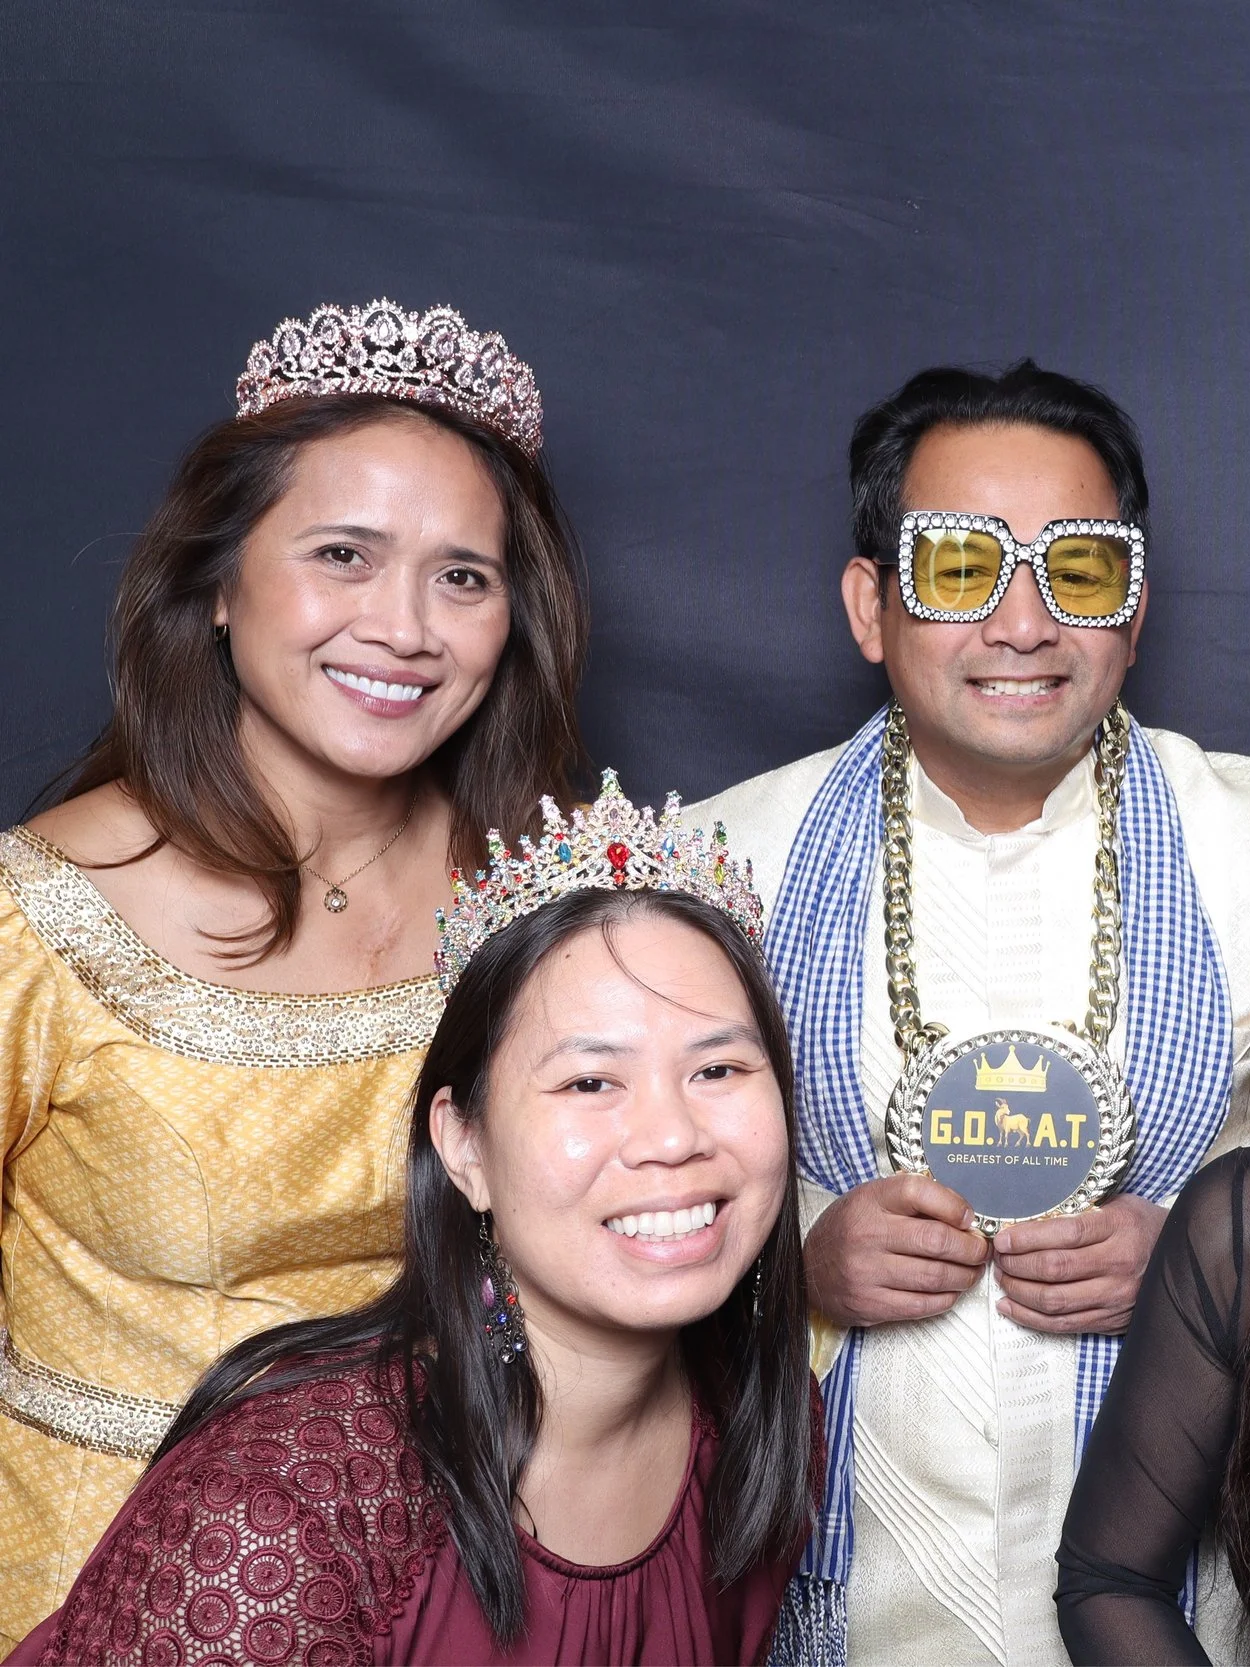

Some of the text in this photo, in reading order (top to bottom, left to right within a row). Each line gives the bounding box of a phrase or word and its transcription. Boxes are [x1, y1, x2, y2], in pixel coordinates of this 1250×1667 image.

[947, 1153, 1069, 1166] GREATEST OF ALL TIME
